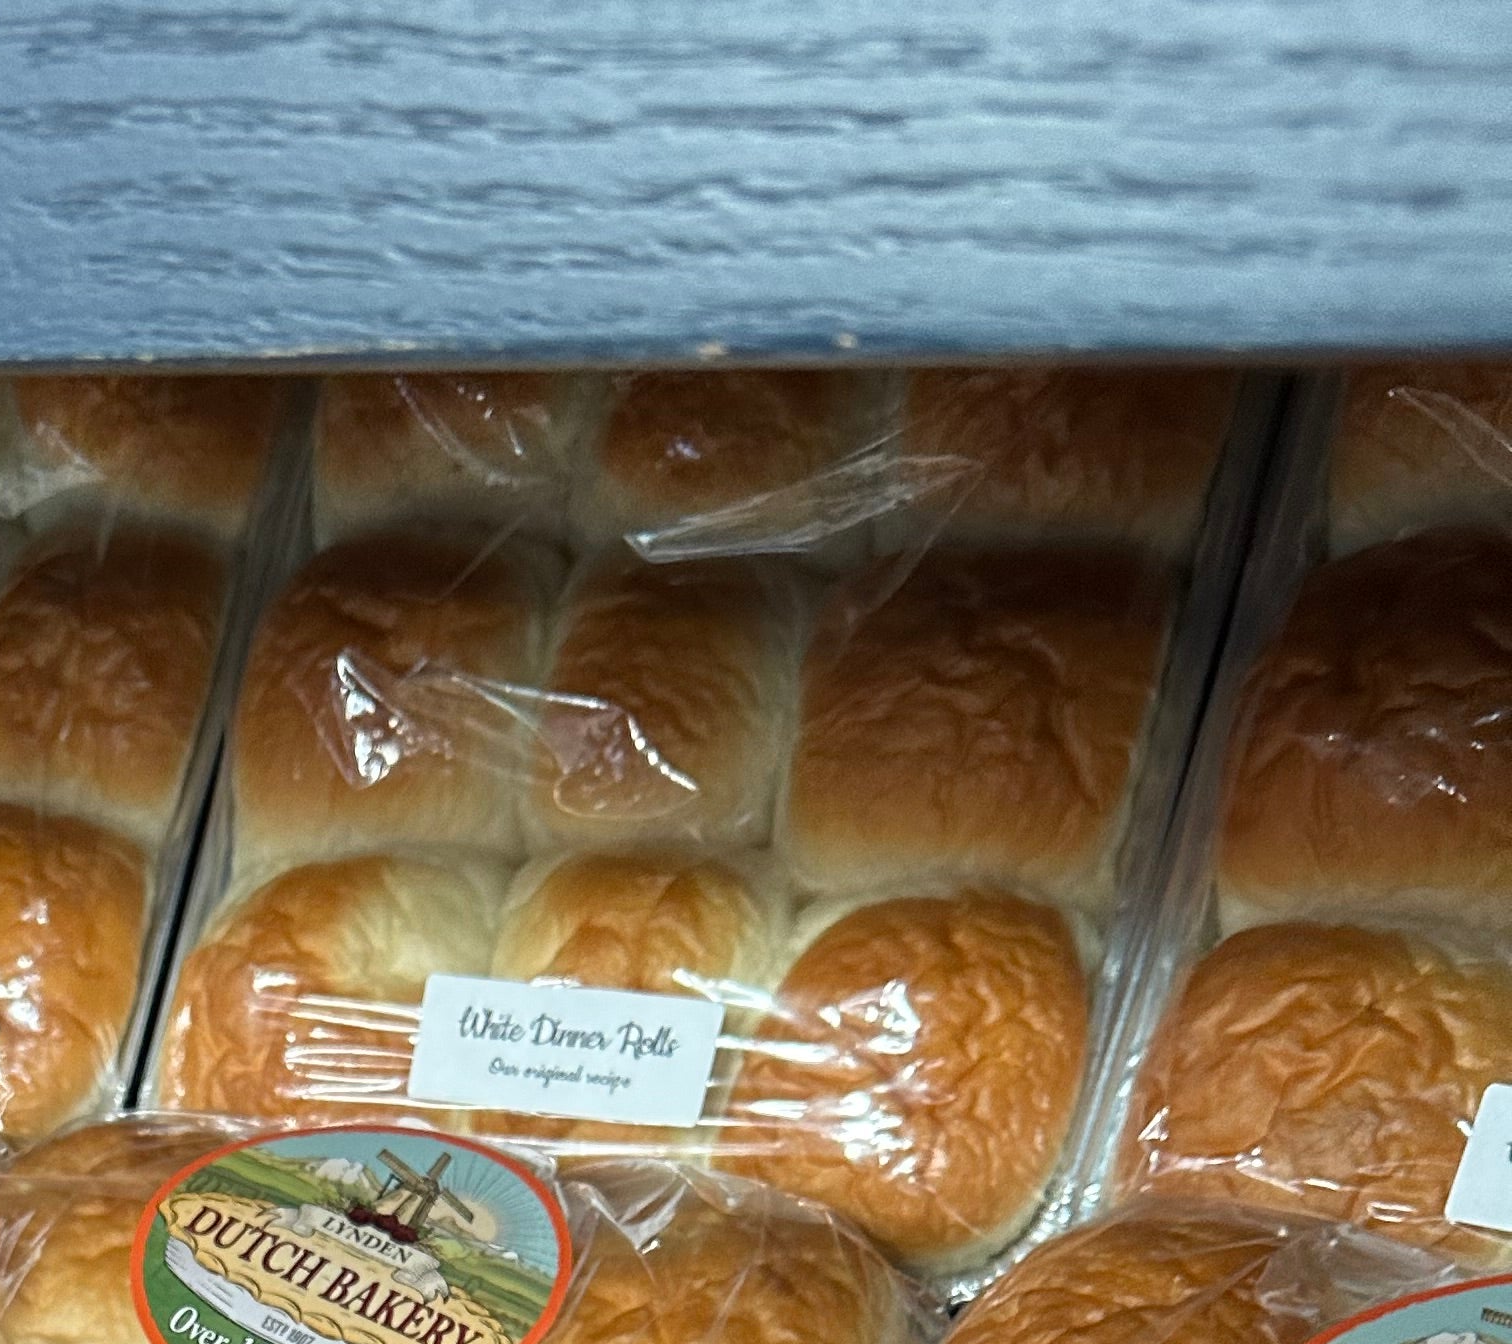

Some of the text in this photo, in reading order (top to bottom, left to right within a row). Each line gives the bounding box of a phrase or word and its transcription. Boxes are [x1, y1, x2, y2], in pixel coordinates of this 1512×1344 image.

[459, 1005, 679, 1059] White Dinner Rolls
[184, 1204, 322, 1291] DUTCH
[322, 1215, 415, 1265] LYNDEN
